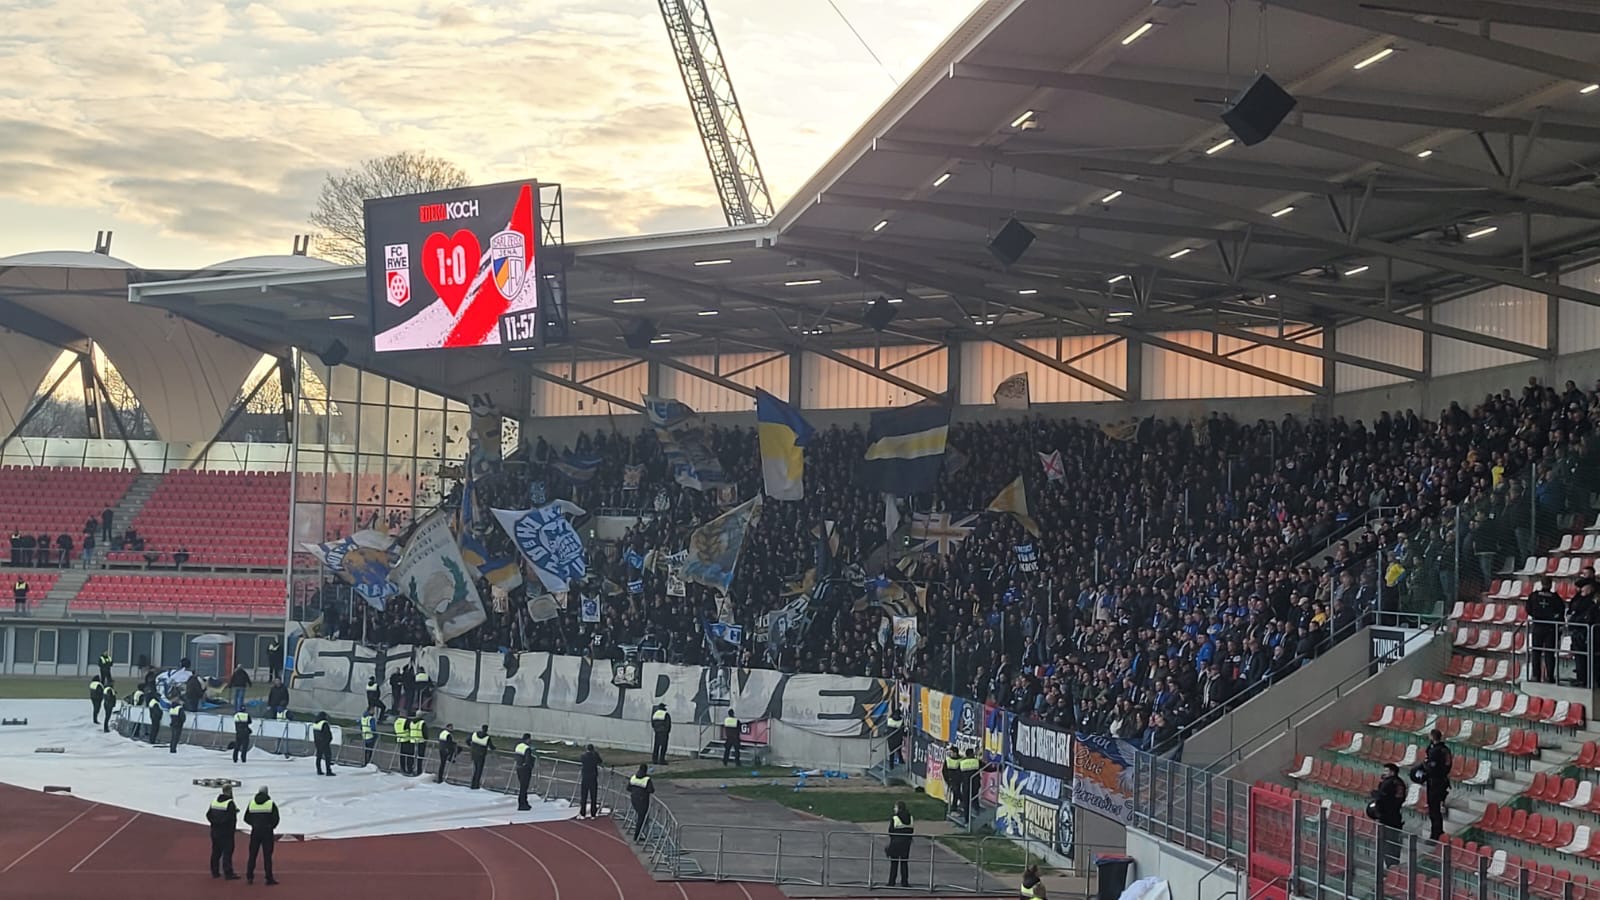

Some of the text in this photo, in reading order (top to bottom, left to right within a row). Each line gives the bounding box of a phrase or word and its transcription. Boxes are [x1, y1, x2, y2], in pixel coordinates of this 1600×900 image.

[446, 199, 479, 220] KOCH
[390, 246, 403, 257] FC
[498, 248, 518, 257] JENA
[387, 256, 408, 269] RWE
[436, 245, 466, 286] 1:0
[504, 312, 536, 342] 11:57
[1372, 637, 1402, 660] TUNNEL
